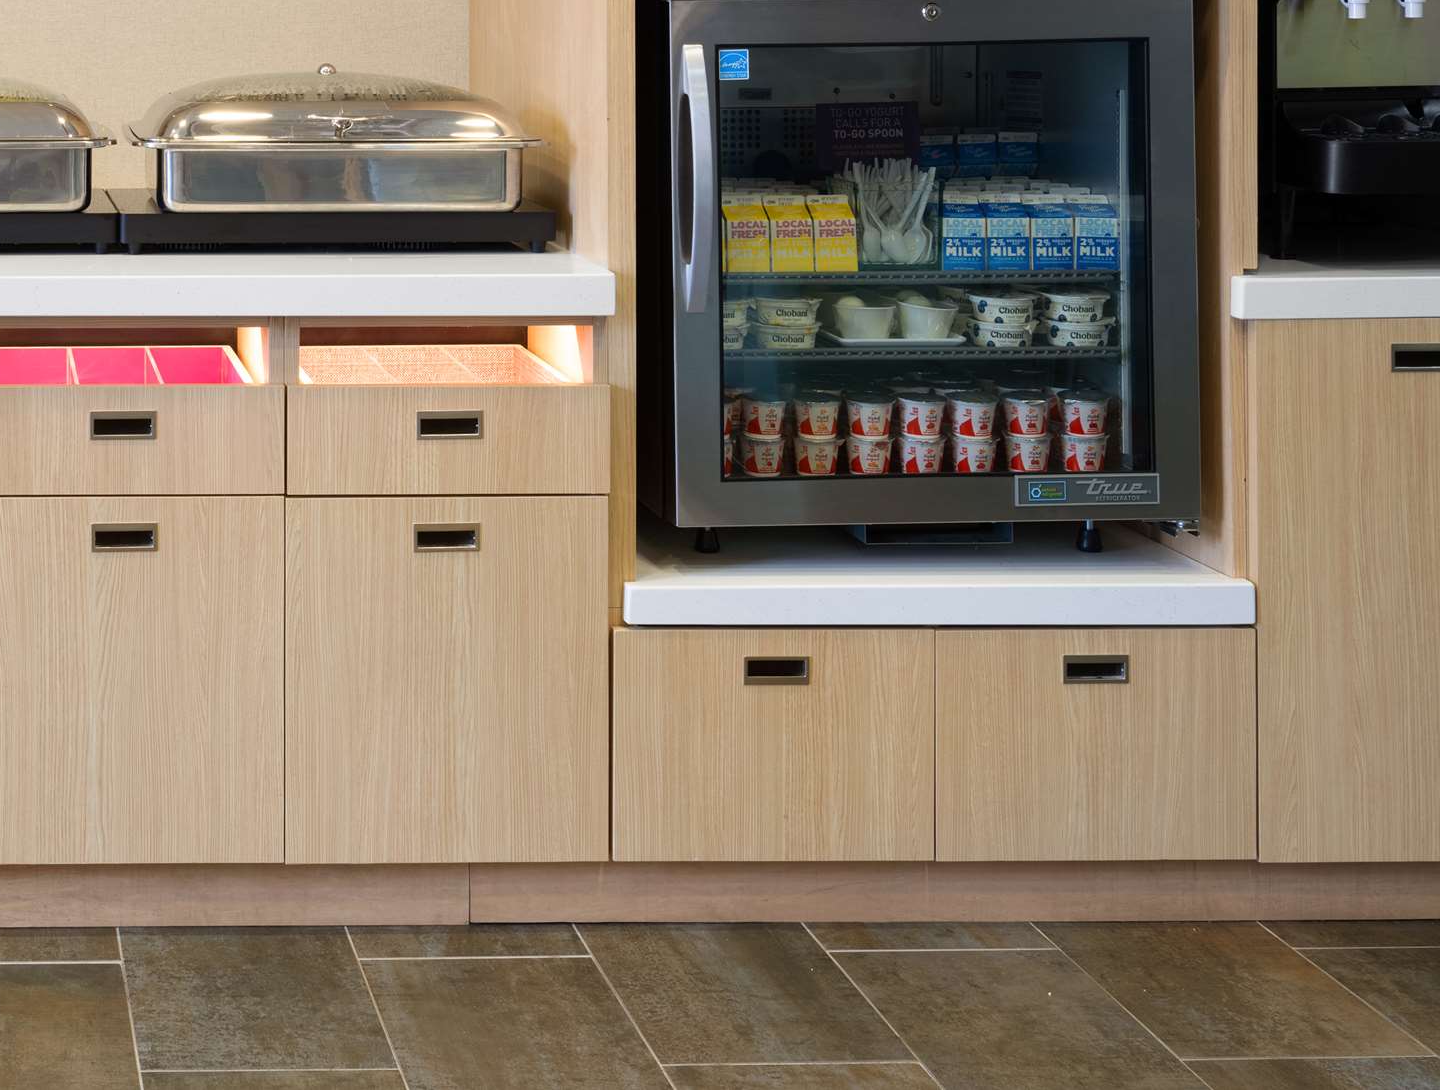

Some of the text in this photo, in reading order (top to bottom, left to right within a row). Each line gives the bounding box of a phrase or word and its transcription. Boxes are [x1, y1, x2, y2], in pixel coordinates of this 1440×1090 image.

[833, 128, 904, 139] TO-GO SPOON
[731, 221, 767, 229] LOCAL
[775, 220, 812, 228] LOCAL
[818, 219, 855, 228] LOCAL
[731, 229, 766, 239] FRESH
[776, 229, 812, 238] FRESH
[819, 228, 855, 237] FRESH
[946, 238, 961, 246] 2%
[990, 238, 1006, 246] 2%
[1036, 238, 1051, 246] 2%
[1080, 238, 1095, 246] 2%
[945, 246, 982, 257] MILK
[990, 246, 1027, 257] MILK
[1036, 246, 1072, 257] MILK
[1079, 246, 1115, 257] MILK
[999, 306, 1029, 315] Chobani
[1062, 304, 1096, 313] Chobani
[775, 309, 809, 318] Chobani
[724, 334, 739, 343] bani
[772, 334, 806, 343] Chobani
[991, 331, 1024, 340] Chobani
[1070, 331, 1102, 340] Chobani
